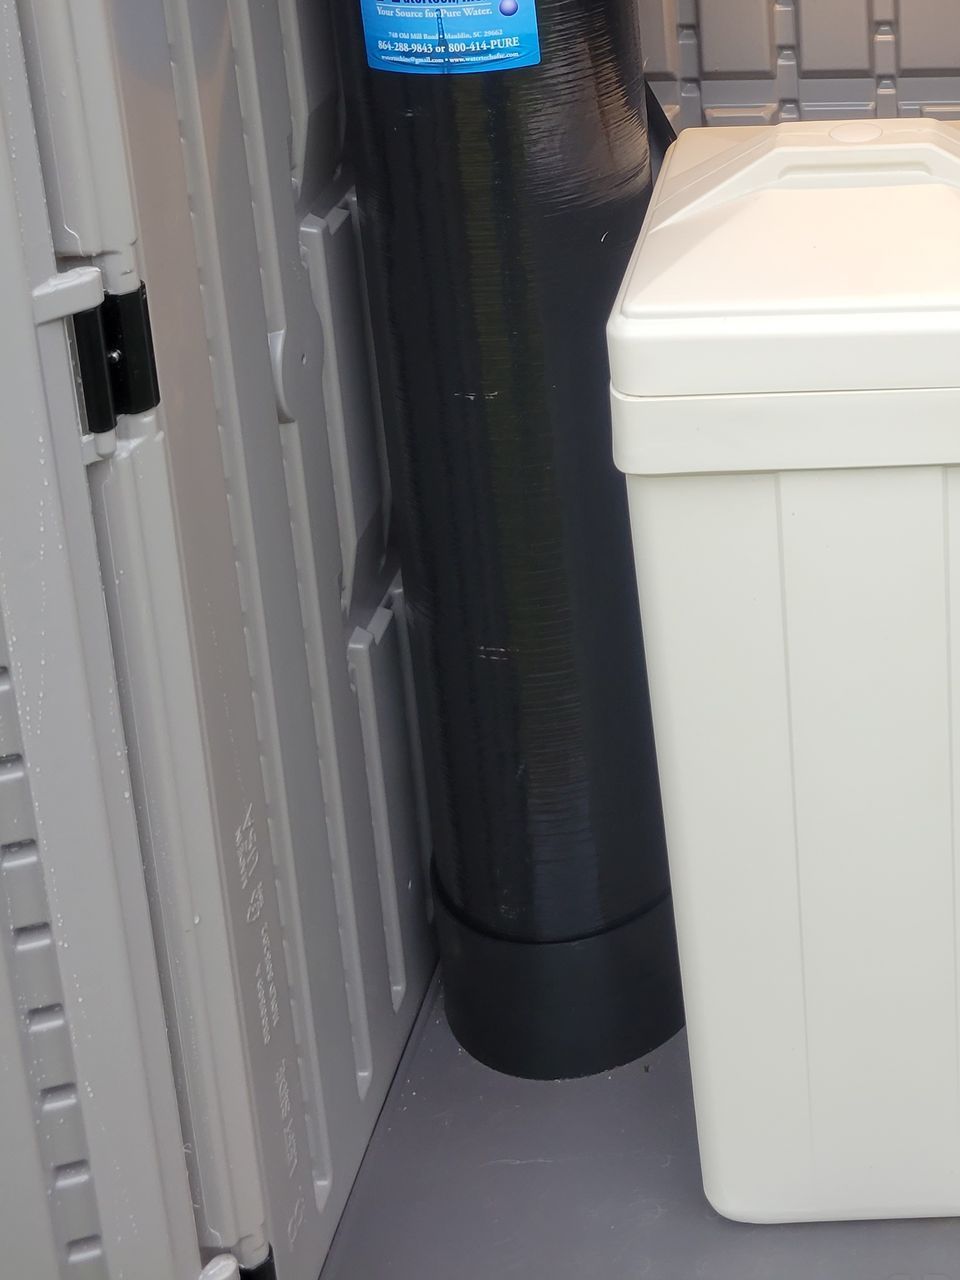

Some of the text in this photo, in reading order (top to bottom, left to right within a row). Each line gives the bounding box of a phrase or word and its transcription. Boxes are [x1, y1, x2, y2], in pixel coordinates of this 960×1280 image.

[376, 6, 493, 18] Your Source for Pure Water.
[377, 40, 433, 54] 864-288-9843
[448, 36, 520, 53] 800-414-PURE
